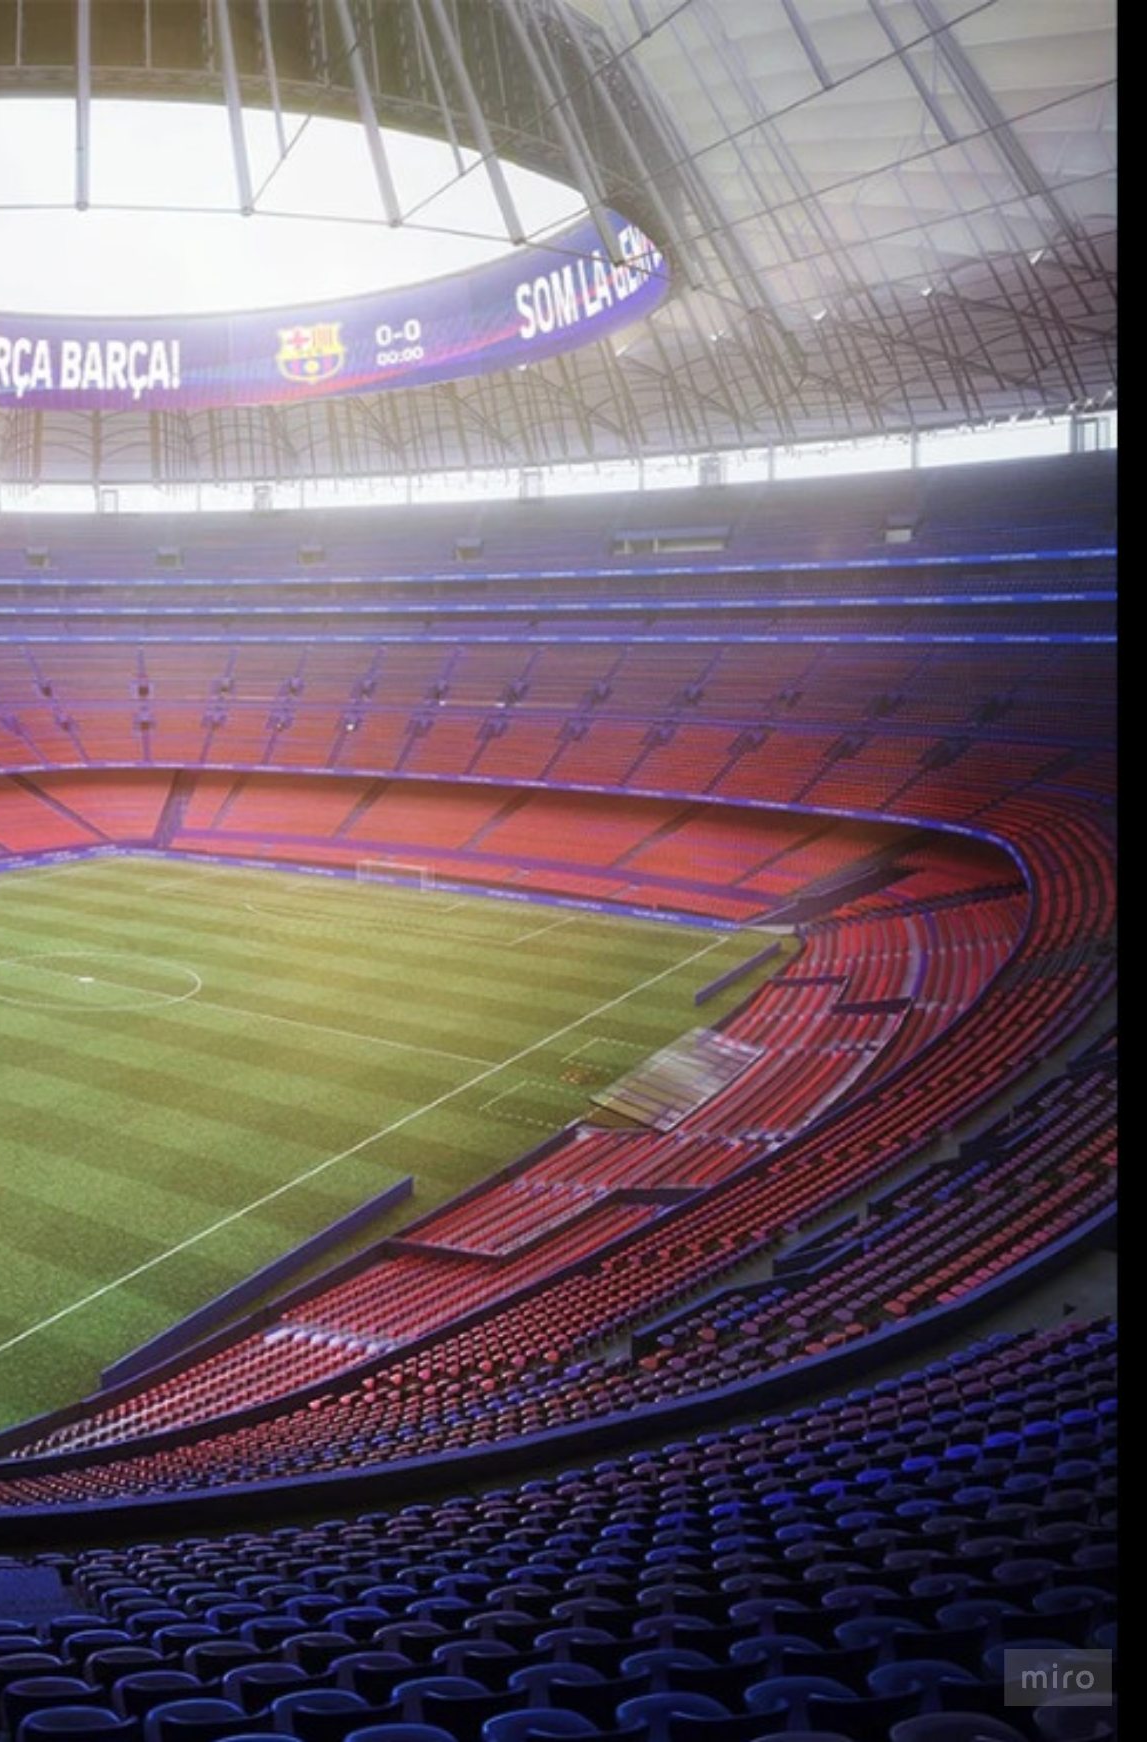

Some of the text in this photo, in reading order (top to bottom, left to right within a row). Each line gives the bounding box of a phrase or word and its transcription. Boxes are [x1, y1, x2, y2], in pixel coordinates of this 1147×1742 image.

[515, 264, 580, 339] SOM
[577, 250, 614, 317] LA
[375, 318, 421, 346] 0-0
[59, 338, 181, 400] BARÇA!
[376, 346, 424, 367] 00:00
